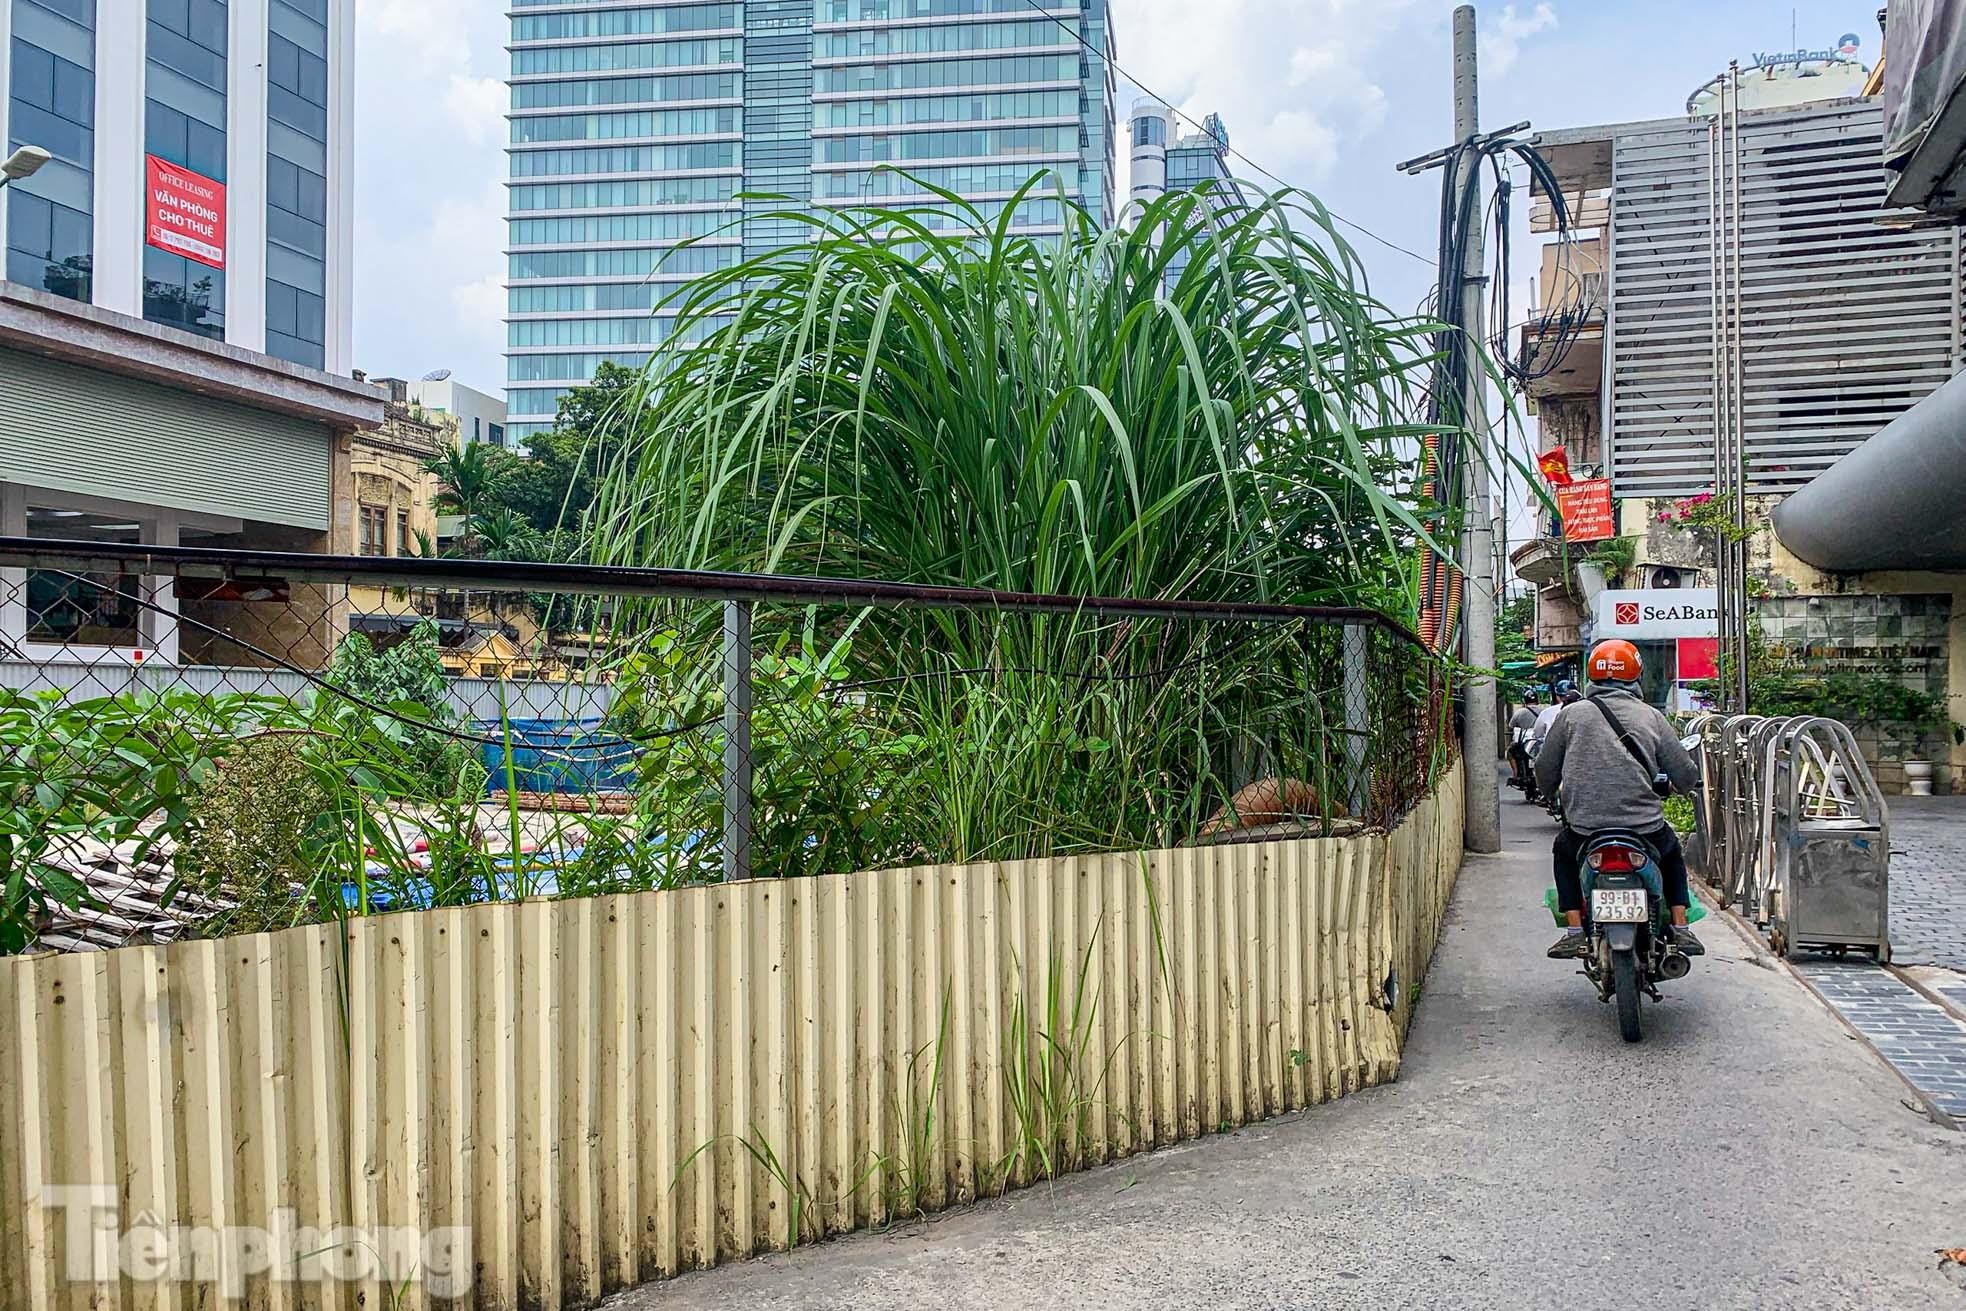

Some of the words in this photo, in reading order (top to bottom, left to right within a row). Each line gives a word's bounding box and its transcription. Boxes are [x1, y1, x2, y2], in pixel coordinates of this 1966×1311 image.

[1752, 47, 1839, 64] VietinBank
[159, 172, 185, 188] OFFICE
[185, 181, 214, 201] LEASING
[154, 189, 178, 208] VĂN
[180, 198, 218, 223] PHÒNG
[159, 209, 184, 226] CHO
[185, 217, 214, 238] THUÊ
[1643, 604, 1730, 621] SeABan
